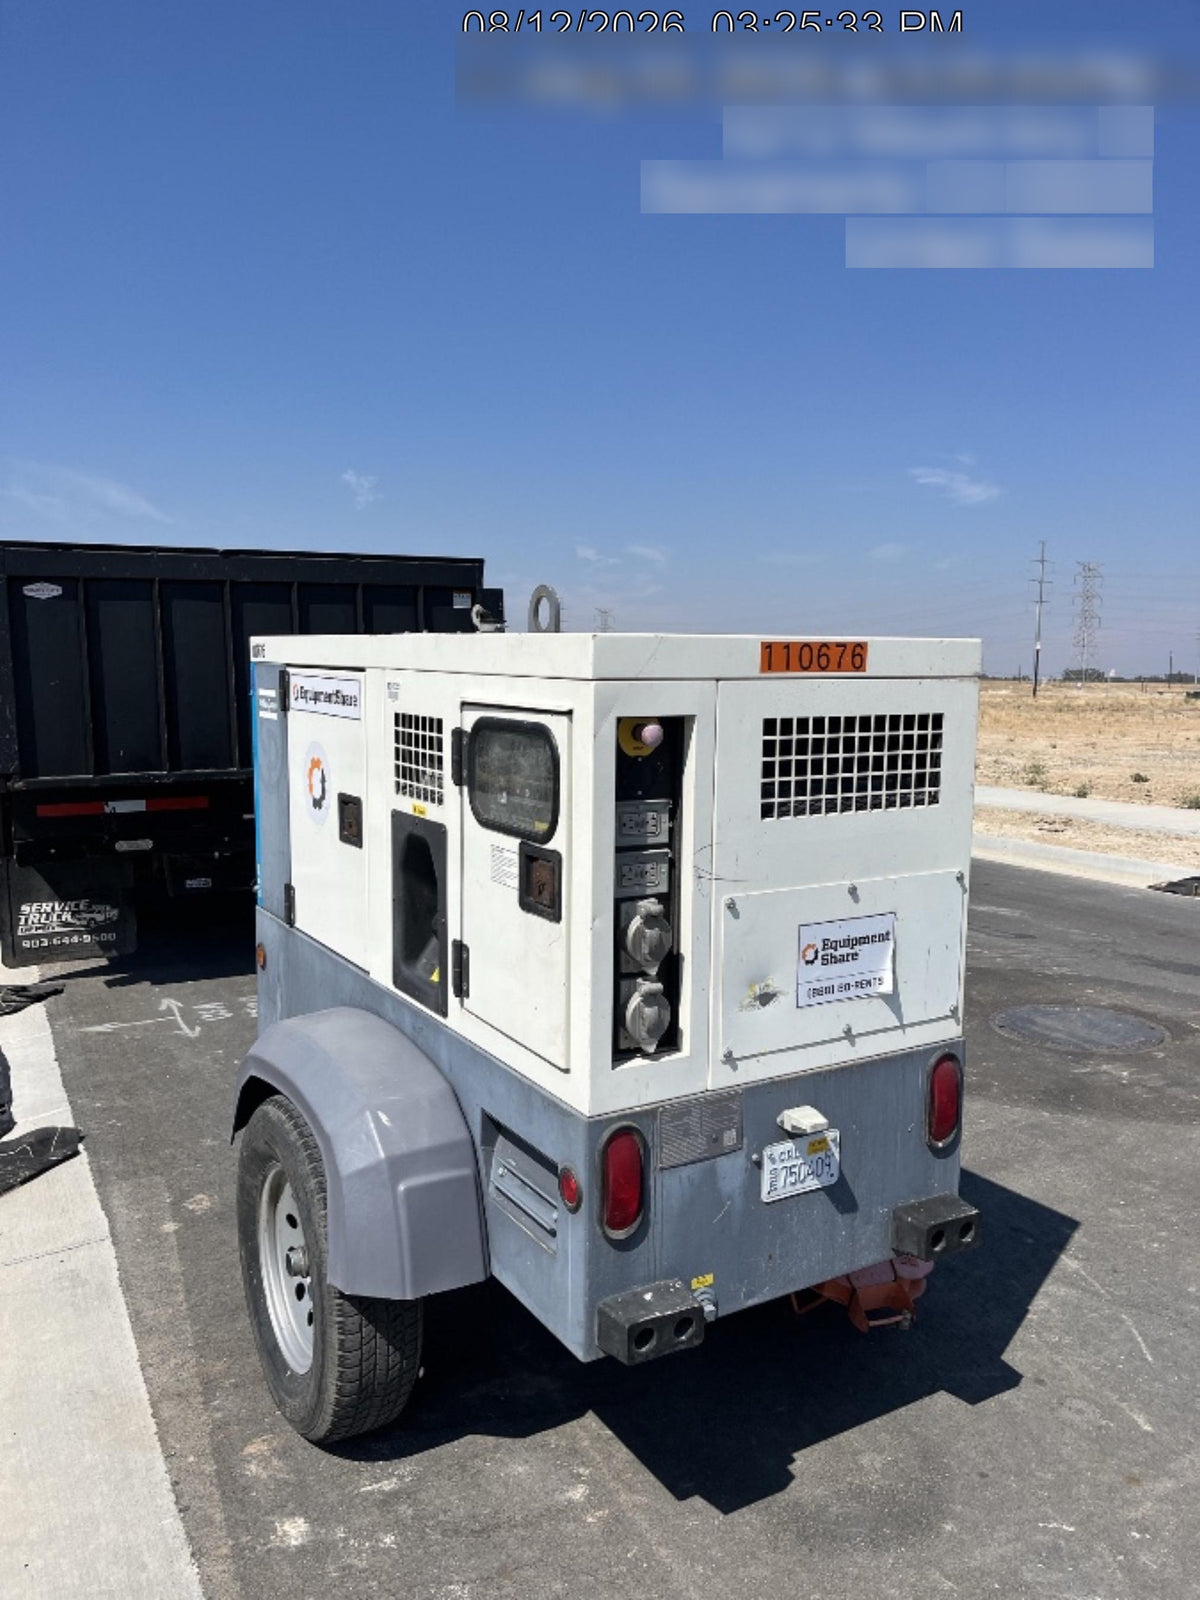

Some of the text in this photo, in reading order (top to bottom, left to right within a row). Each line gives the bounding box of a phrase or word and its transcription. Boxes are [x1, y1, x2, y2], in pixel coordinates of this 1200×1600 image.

[765, 643, 864, 671] 110676
[20, 899, 90, 914] SERVICE
[18, 911, 72, 925] TRUCK
[821, 929, 891, 952] Equipment
[821, 952, 859, 966] Share
